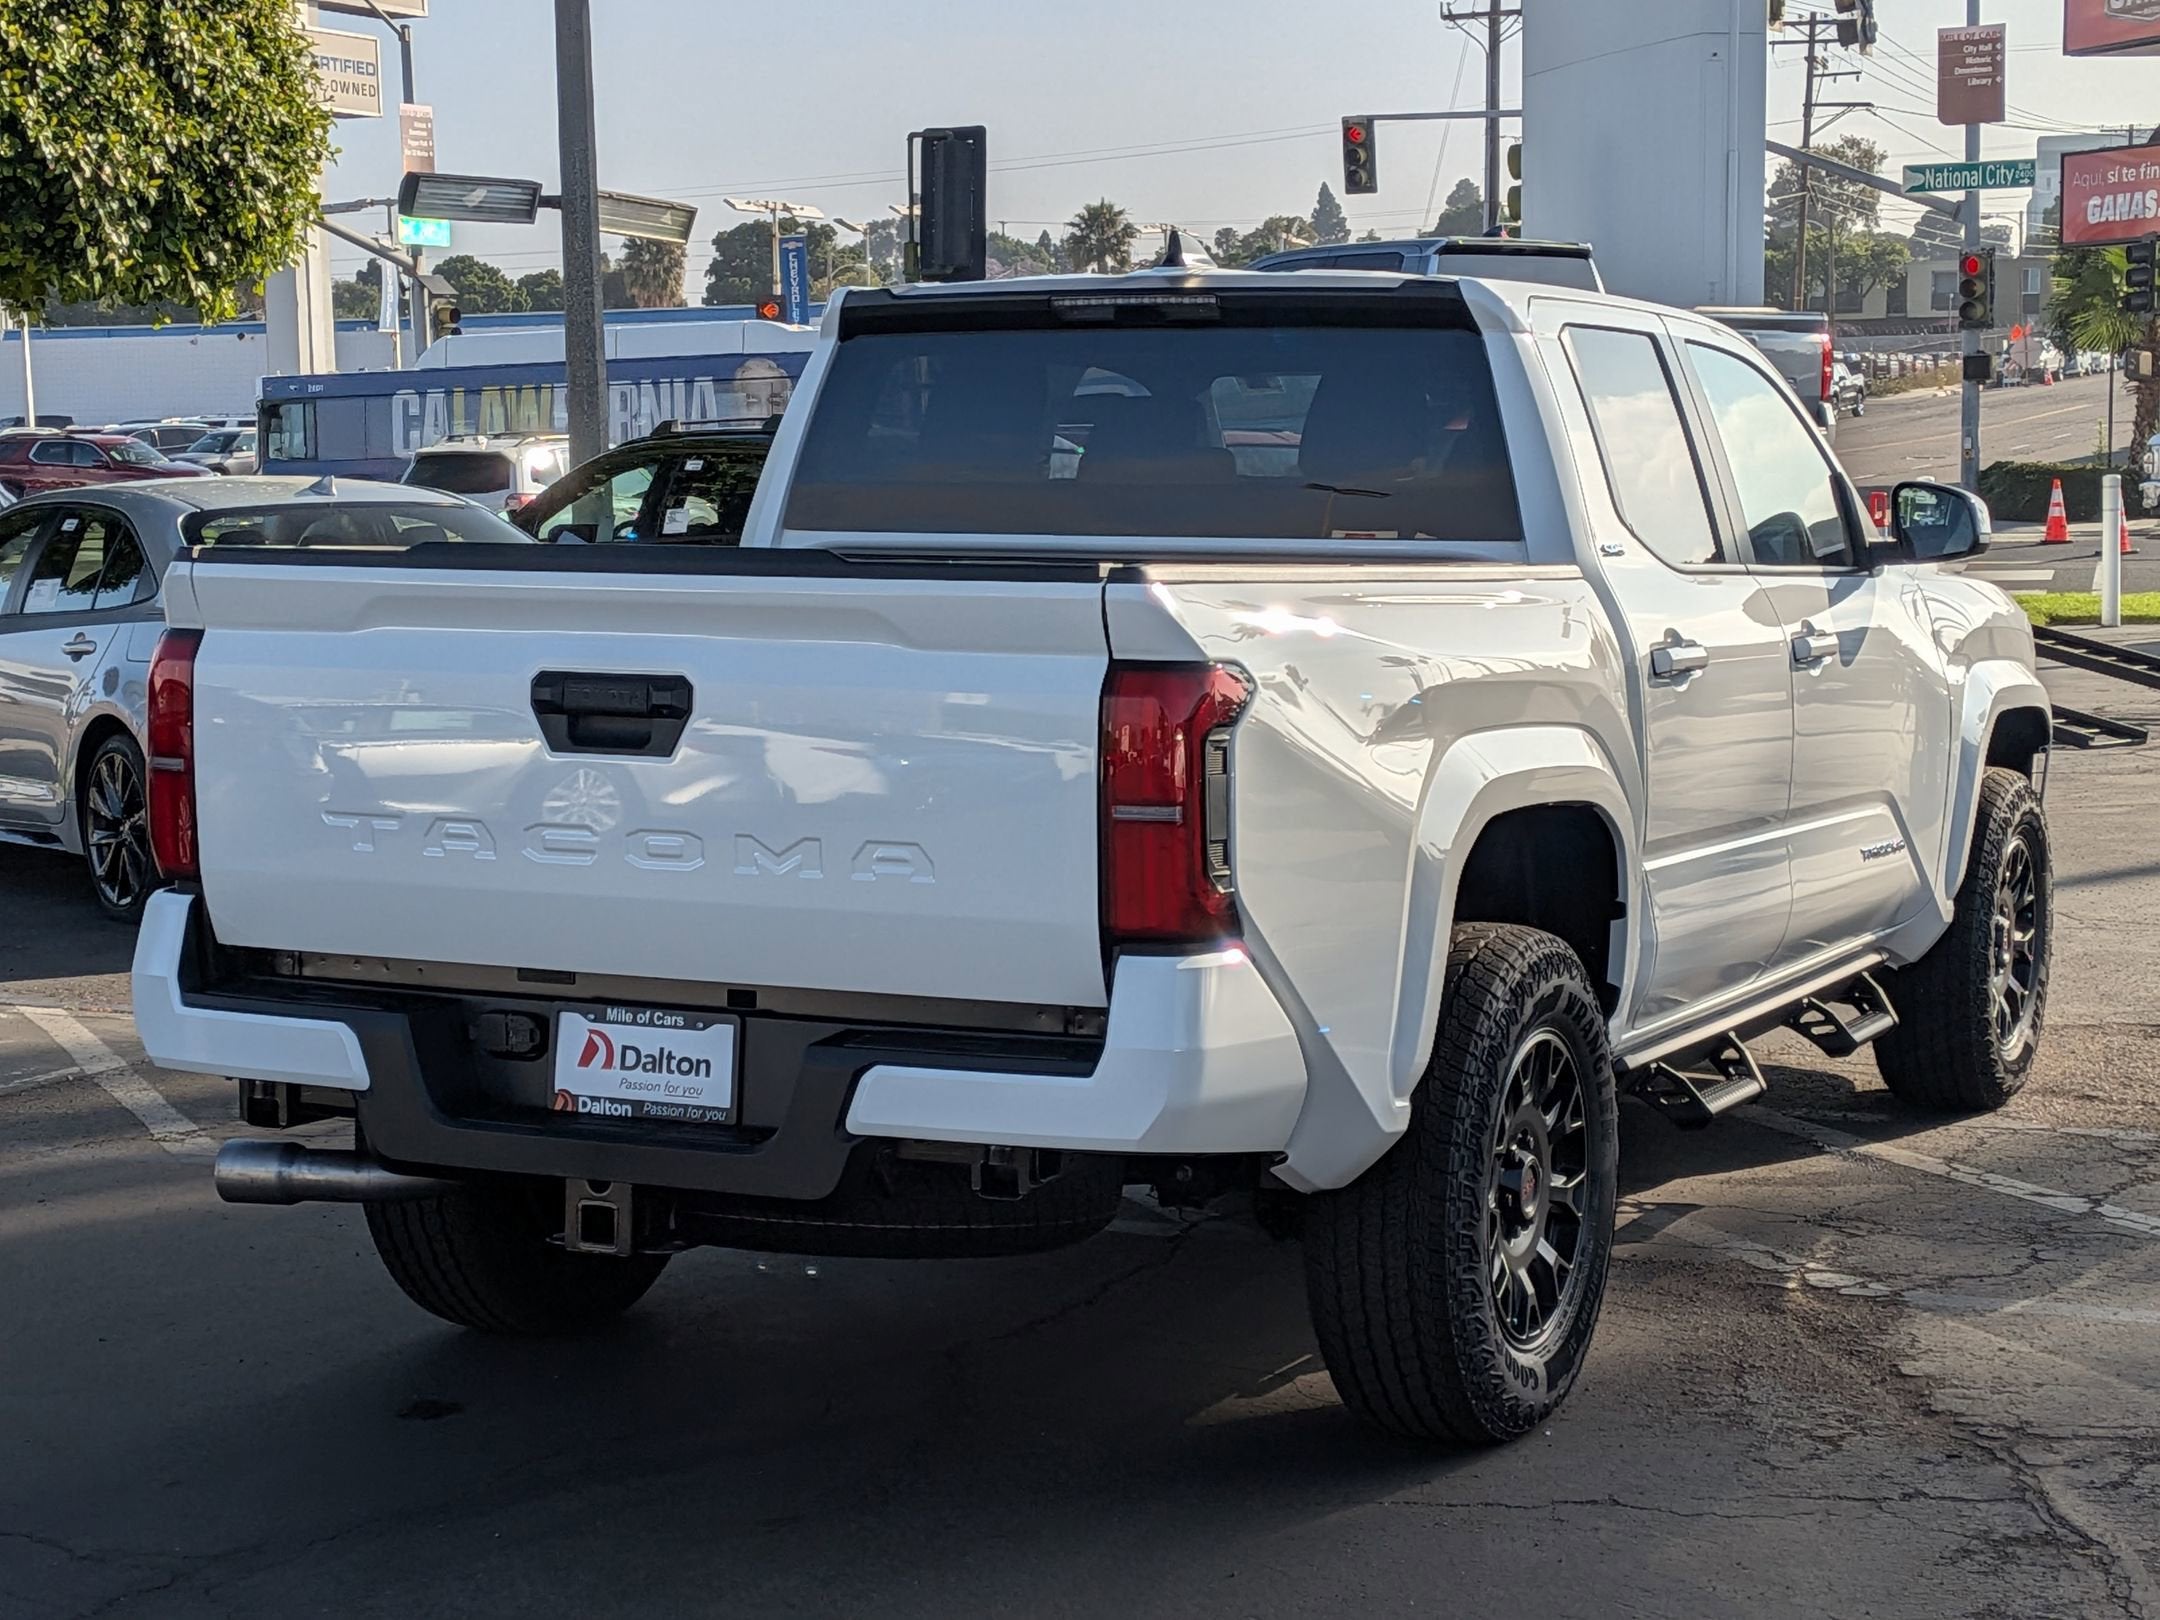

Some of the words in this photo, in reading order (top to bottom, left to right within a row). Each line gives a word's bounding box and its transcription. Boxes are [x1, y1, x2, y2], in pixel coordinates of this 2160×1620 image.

[1963, 45, 1977, 54] City
[1979, 43, 1992, 51] Hall
[1967, 77, 1992, 86] Library
[1925, 165, 1982, 189] National
[1986, 164, 2015, 186] City
[2015, 169, 2035, 179] 2400
[2107, 165, 2120, 184] sí
[2122, 167, 2136, 182] te
[320, 810, 936, 884] TACOMA
[606, 1007, 633, 1023] Mile
[636, 1011, 650, 1024] of
[653, 1012, 685, 1027] Cars
[619, 1044, 711, 1078] Dalton
[618, 1078, 660, 1092] Passion
[663, 1080, 680, 1095] for
[681, 1085, 704, 1096] you
[578, 1096, 632, 1117] Dalton
[642, 1103, 685, 1118] Passion
[686, 1106, 703, 1119] for
[705, 1110, 727, 1121] you
